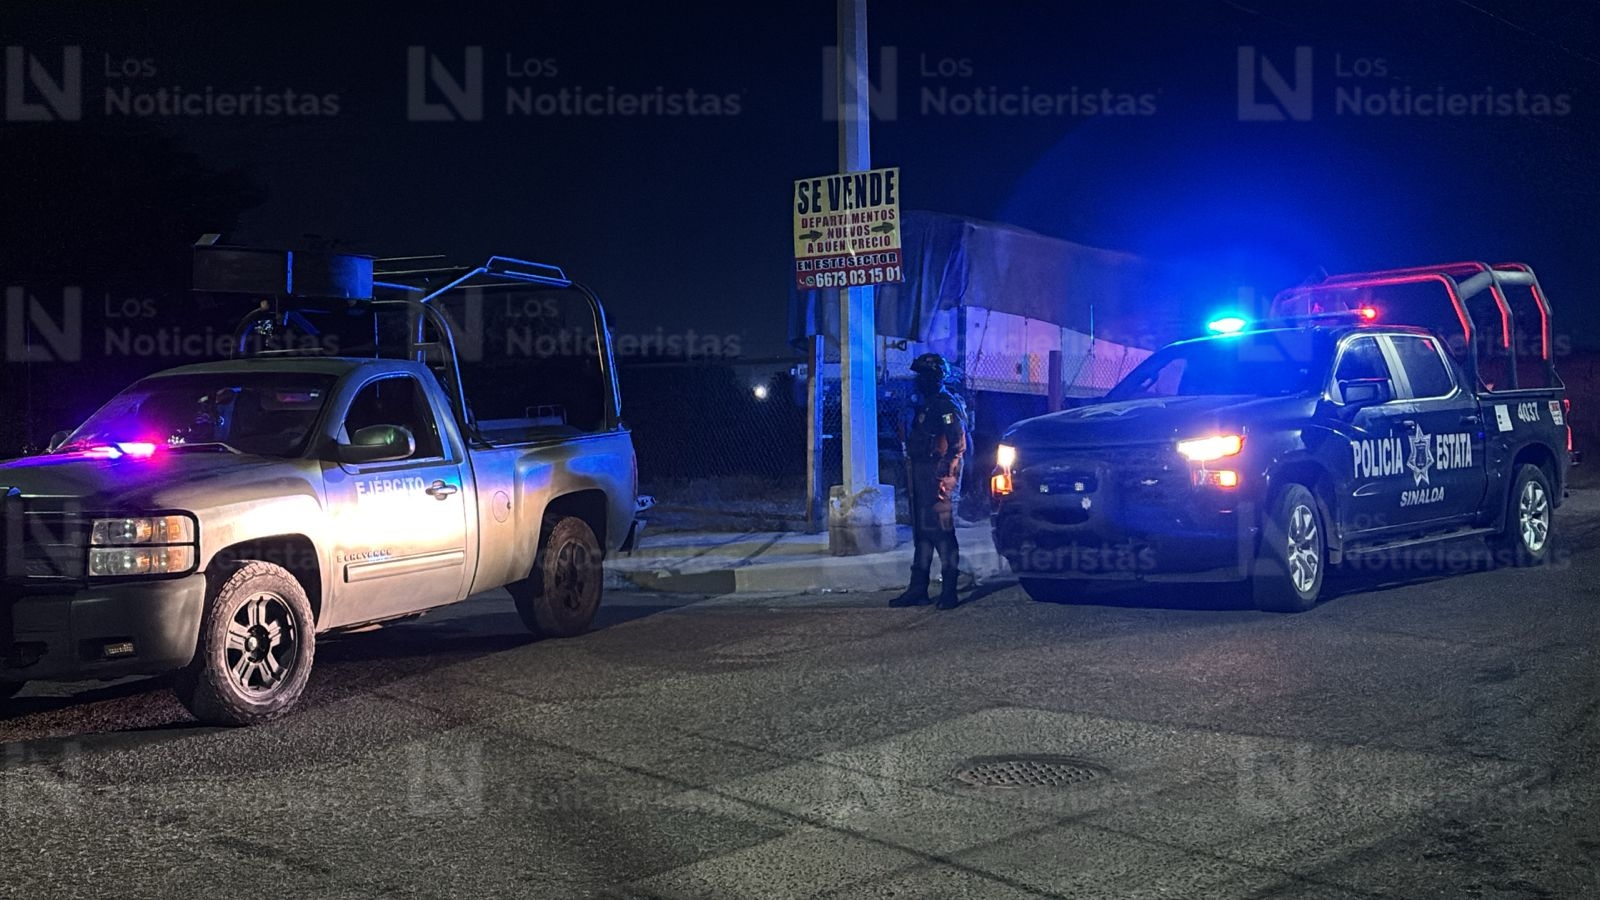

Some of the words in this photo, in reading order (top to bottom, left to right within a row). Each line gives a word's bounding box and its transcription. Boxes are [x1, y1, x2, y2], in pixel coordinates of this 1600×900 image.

[797, 180, 822, 215] SE
[827, 170, 895, 211] VENDE
[807, 242, 814, 254] A
[817, 240, 846, 253] BUEN
[851, 235, 891, 250] PRECIO
[797, 261, 812, 271] EN
[815, 257, 845, 269] ESTE
[847, 252, 898, 267] SECTOR
[815, 271, 847, 288] 6673
[849, 269, 866, 285] 03
[869, 267, 884, 283] 15
[886, 265, 900, 281] 01
[1518, 401, 1540, 424] 4037
[1436, 433, 1473, 469] ESTATA
[355, 475, 424, 496] EJÉRCITO
[1400, 486, 1446, 508] SINALOA
